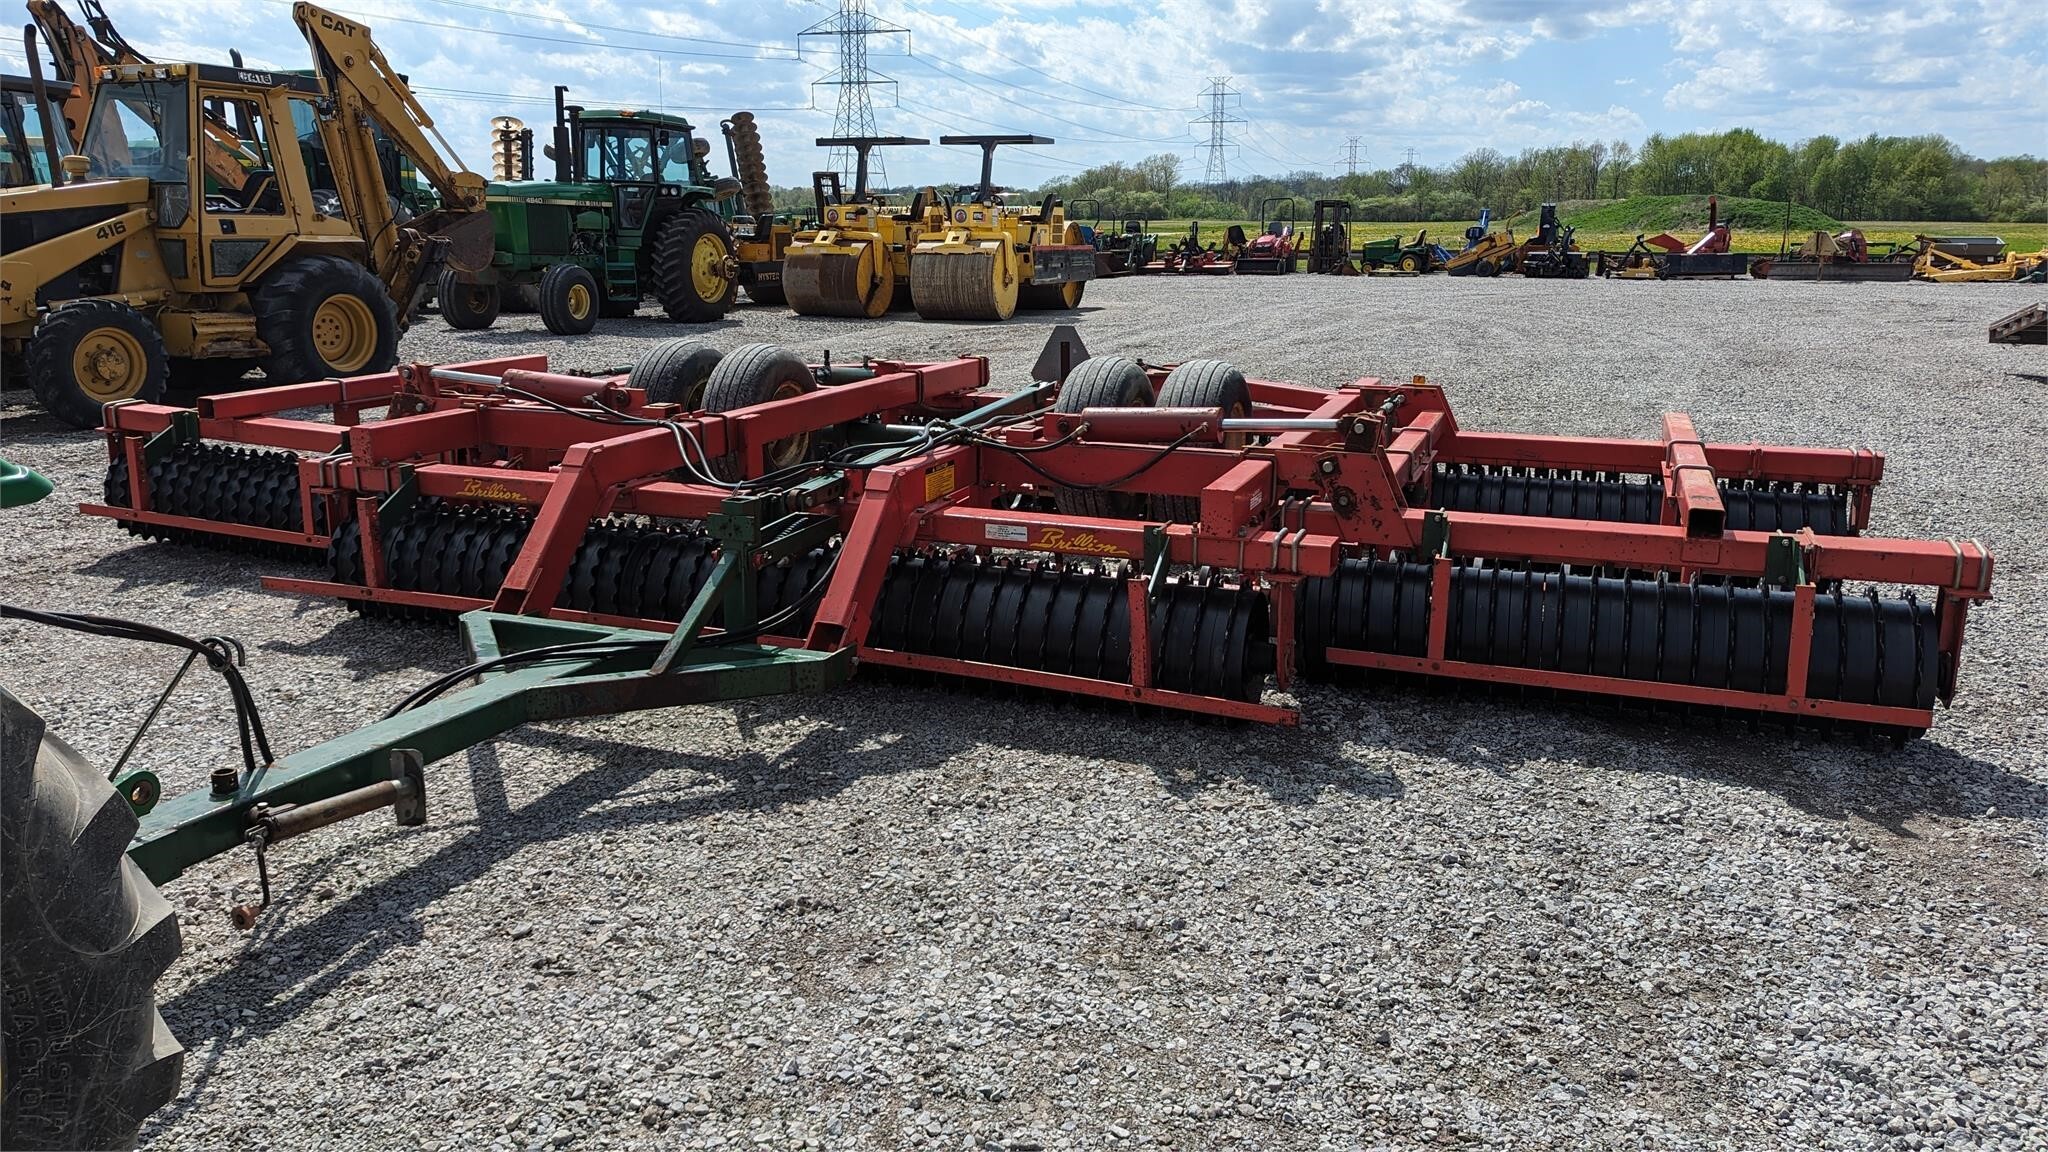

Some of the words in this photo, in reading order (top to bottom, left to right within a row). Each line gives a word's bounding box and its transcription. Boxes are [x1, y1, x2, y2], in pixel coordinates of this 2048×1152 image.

[321, 15, 356, 38] CAT
[96, 221, 126, 240] 416
[757, 272, 780, 281] HYSTER
[456, 479, 527, 501] Brillion
[1030, 528, 1130, 555] Brillion
